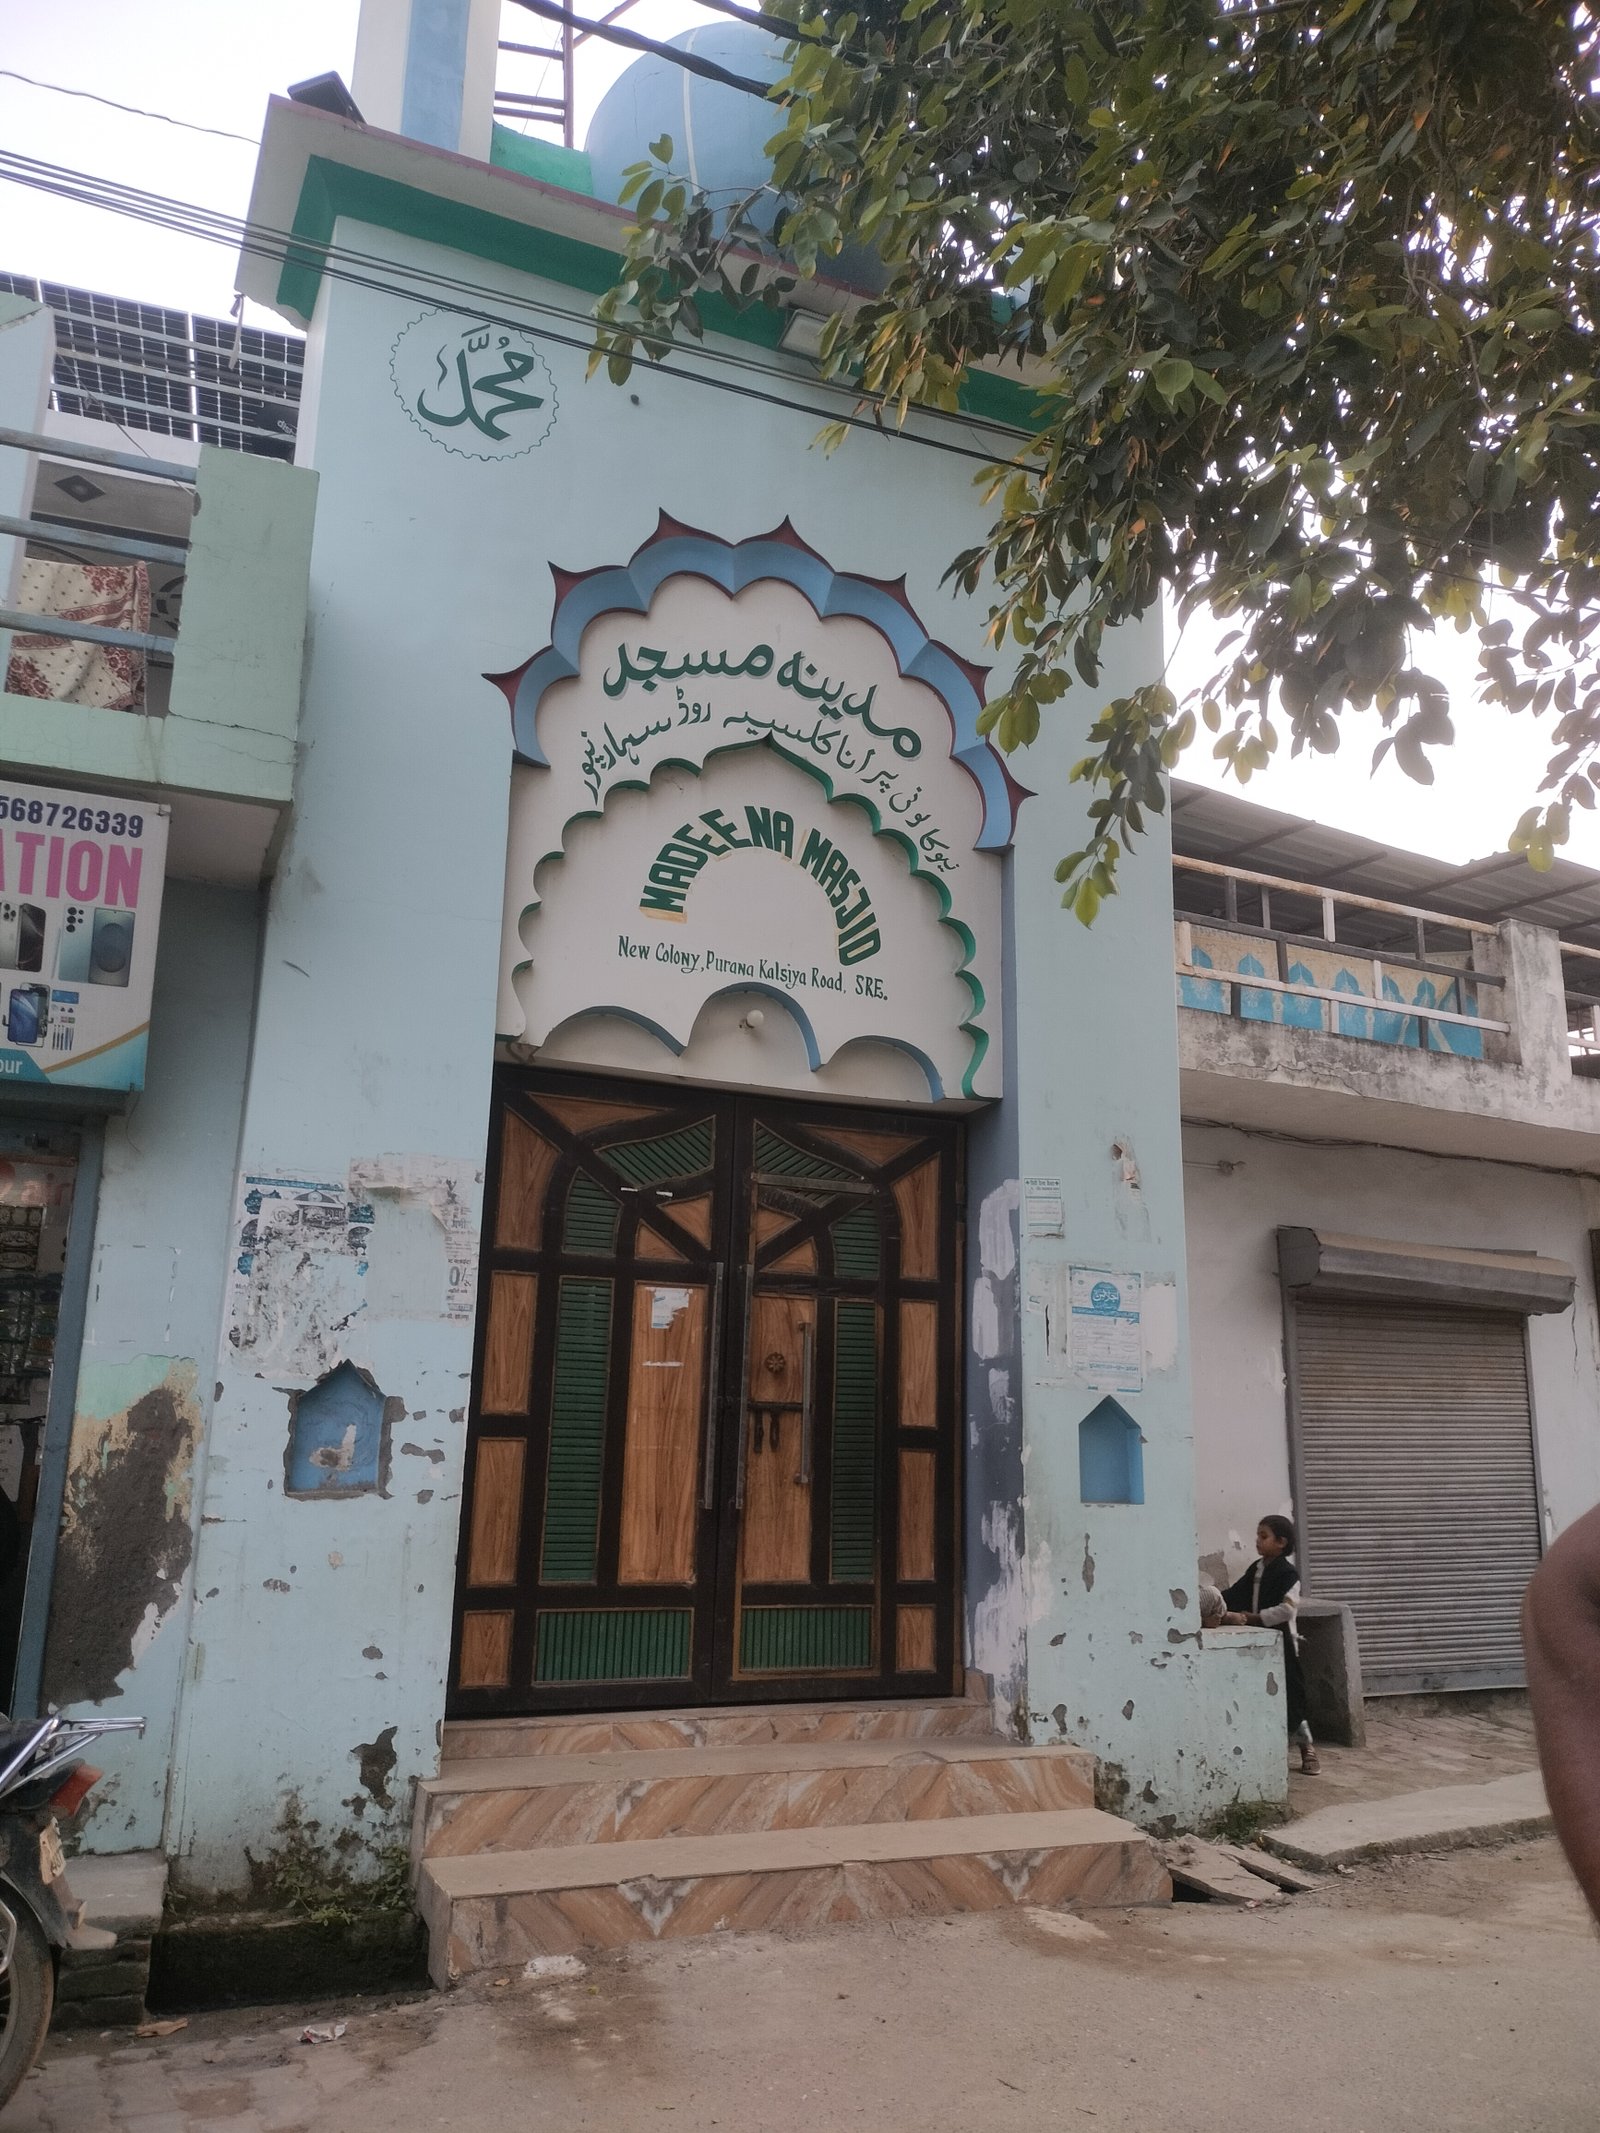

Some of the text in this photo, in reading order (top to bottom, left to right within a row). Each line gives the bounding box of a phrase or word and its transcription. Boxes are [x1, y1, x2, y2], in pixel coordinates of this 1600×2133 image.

[602, 642, 775, 698] مسجد
[676, 685, 711, 727] روڈ
[0, 827, 144, 909] TION
[639, 805, 882, 967] MADEENA MASJID
[617, 935, 651, 960] New
[705, 950, 755, 978] Purana
[758, 958, 807, 990] Kalsiya
[811, 967, 848, 994] Road,
[855, 974, 889, 1001] SRE.
